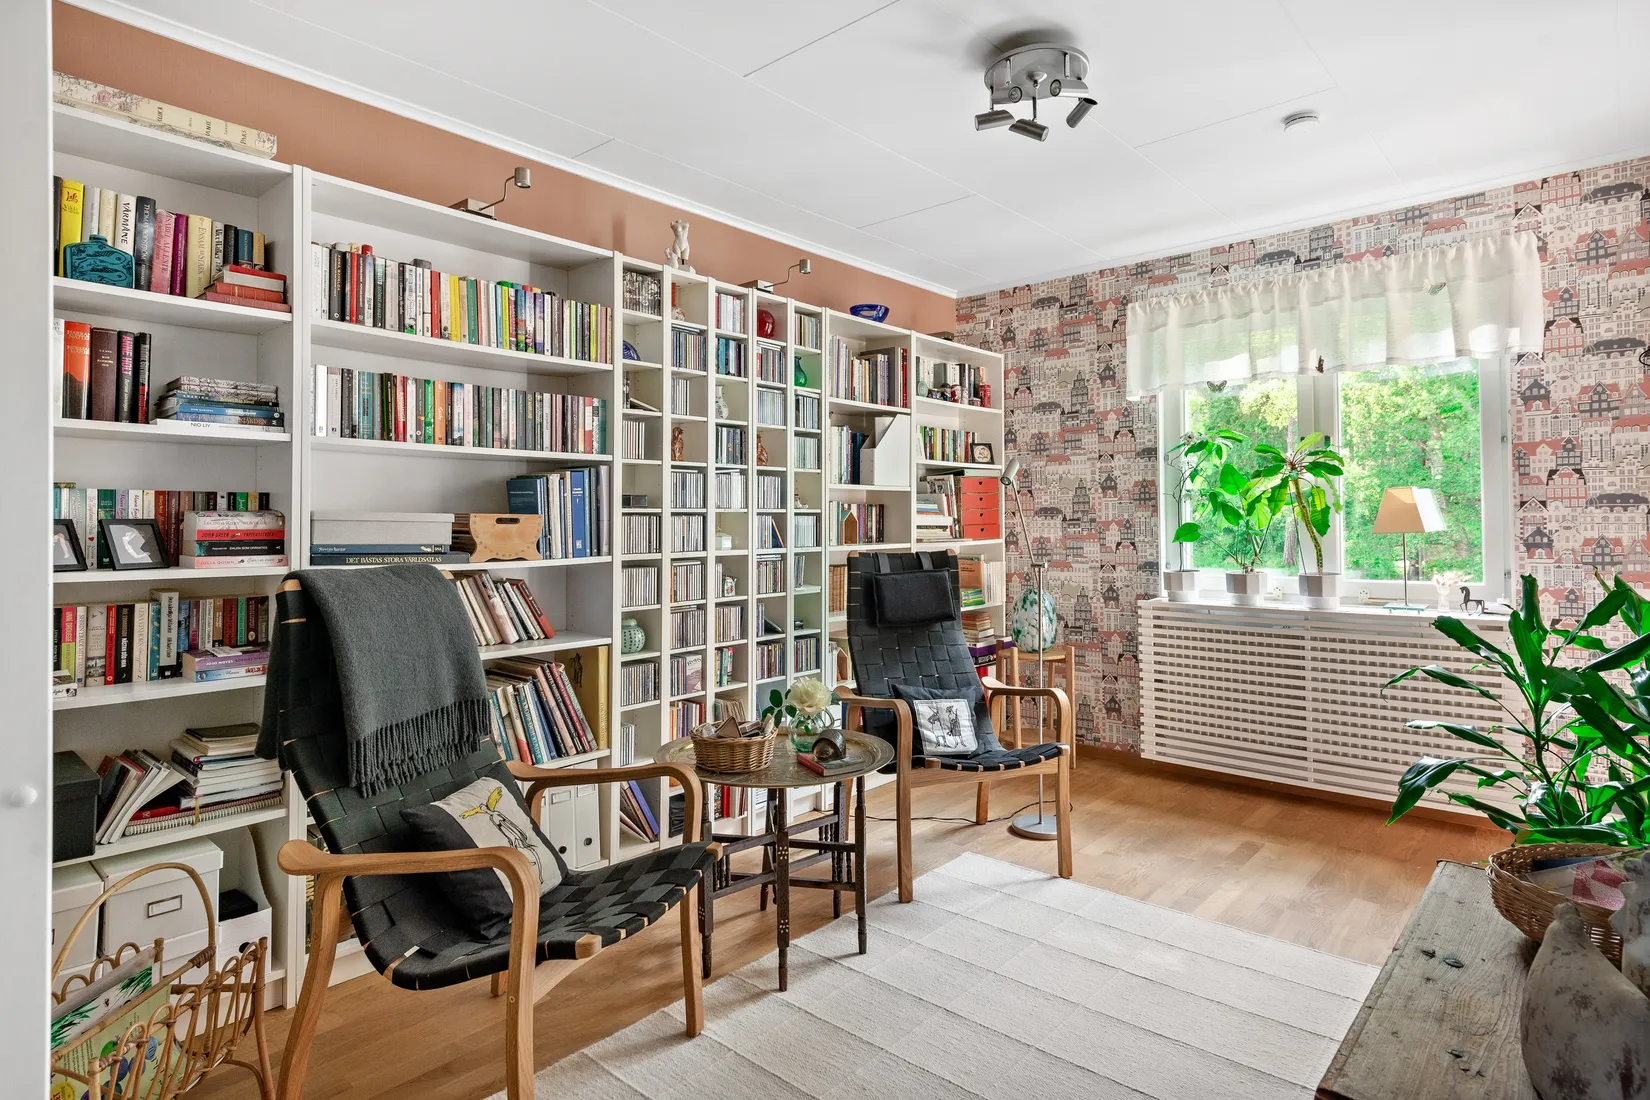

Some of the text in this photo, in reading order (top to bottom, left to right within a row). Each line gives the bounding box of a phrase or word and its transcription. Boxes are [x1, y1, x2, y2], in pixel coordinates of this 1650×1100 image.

[120, 202, 131, 245] VÅRMÅNE
[142, 204, 150, 229] THOMAS
[140, 229, 149, 260] BODSTRÖM
[161, 214, 172, 274] ISABEL ALLENDE
[198, 227, 206, 248] ENSAM
[198, 255, 206, 275] STARK
[121, 335, 133, 356] ANNE
[121, 357, 133, 376] HOLT
[360, 556, 383, 564] BÄSTAS
[522, 702, 532, 720] KROPP
